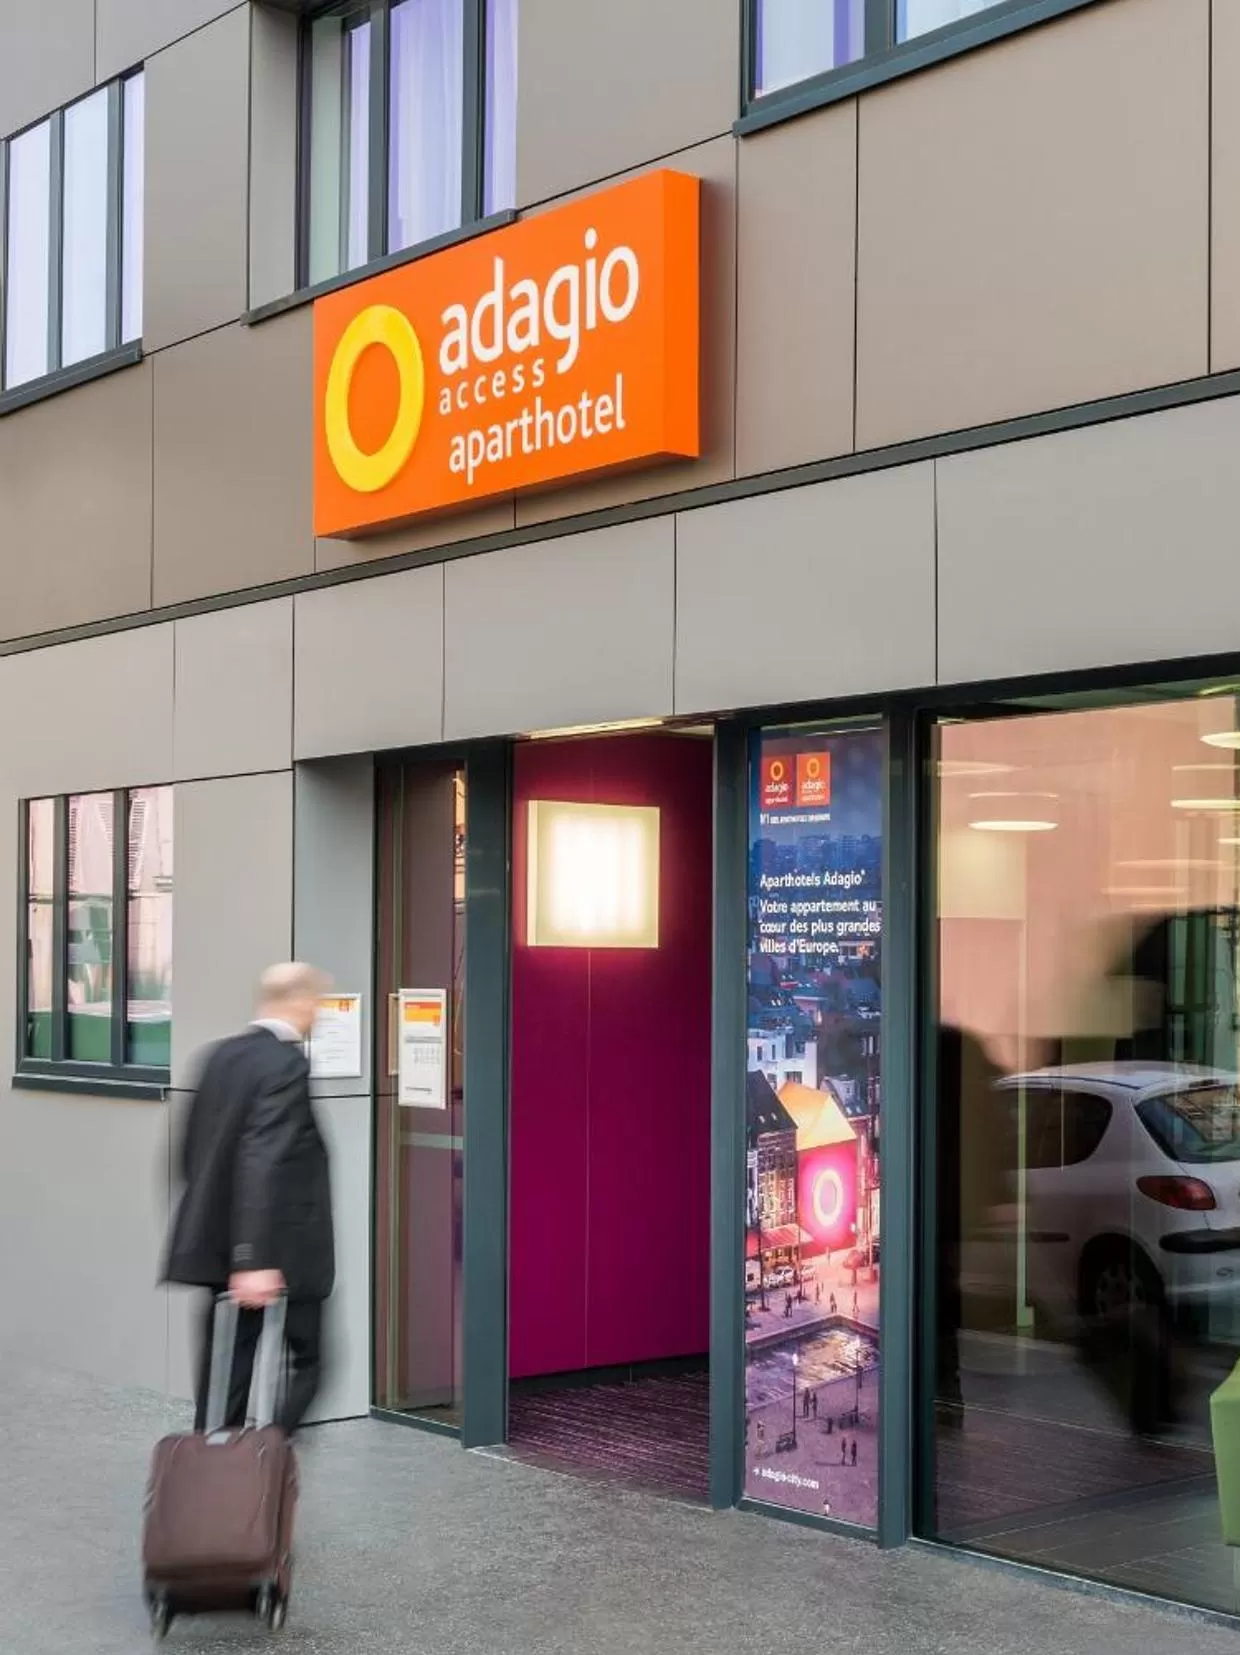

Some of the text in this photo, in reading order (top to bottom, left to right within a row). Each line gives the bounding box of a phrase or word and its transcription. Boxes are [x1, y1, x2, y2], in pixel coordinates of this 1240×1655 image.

[438, 227, 640, 374] adagio
[438, 357, 546, 416] access
[448, 372, 626, 486] aparthotel
[760, 872, 820, 891] Aparthotels
[760, 899, 877, 917] Votre appartement au
[789, 919, 809, 933] des
[811, 918, 835, 937] plus
[836, 919, 881, 937] grandes
[760, 938, 840, 956] villes d'Europe.
